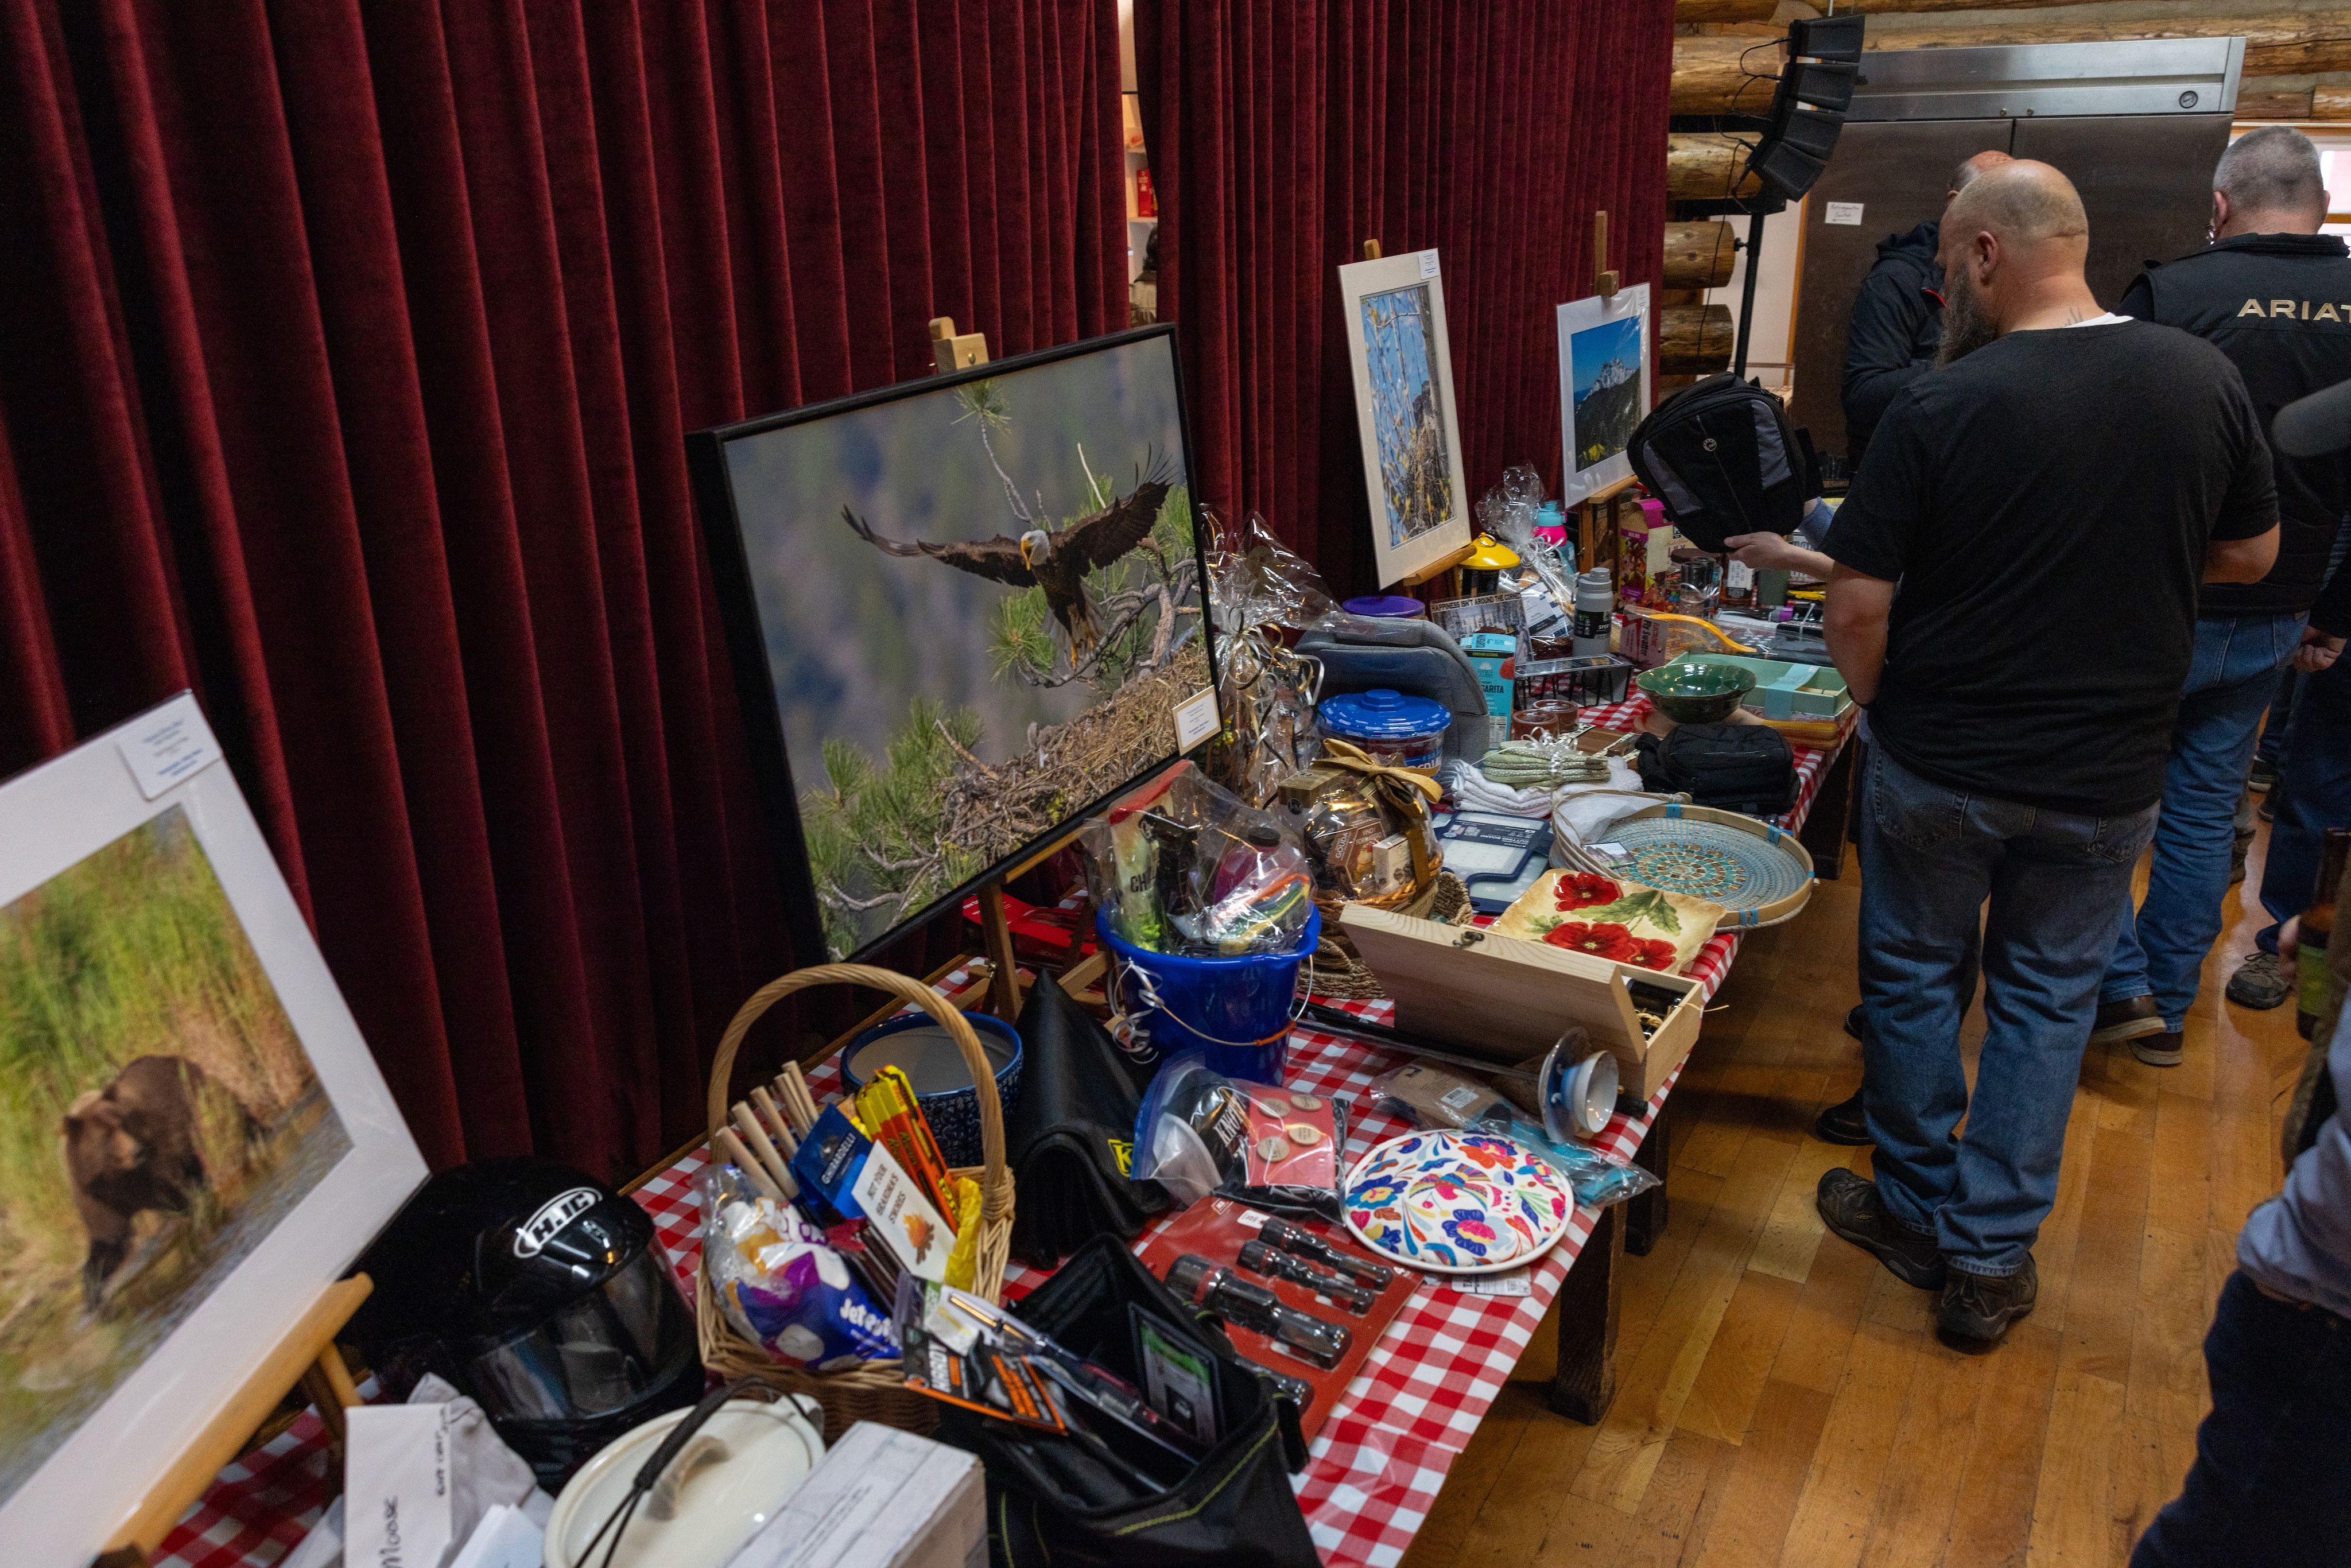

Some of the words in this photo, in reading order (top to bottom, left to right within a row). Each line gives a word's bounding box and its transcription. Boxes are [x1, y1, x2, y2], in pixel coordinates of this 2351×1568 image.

[2237, 298, 2351, 324] ARIAT
[1431, 601, 1460, 612] HAPPINESS
[1461, 599, 1473, 607] ISN'T
[1475, 596, 1494, 606] AROUND
[1643, 619, 1652, 630] Fly
[1640, 631, 1651, 656] Swatter
[1334, 832, 1349, 859] GOUDA
[821, 1132, 856, 1185] GHIRARDELLI
